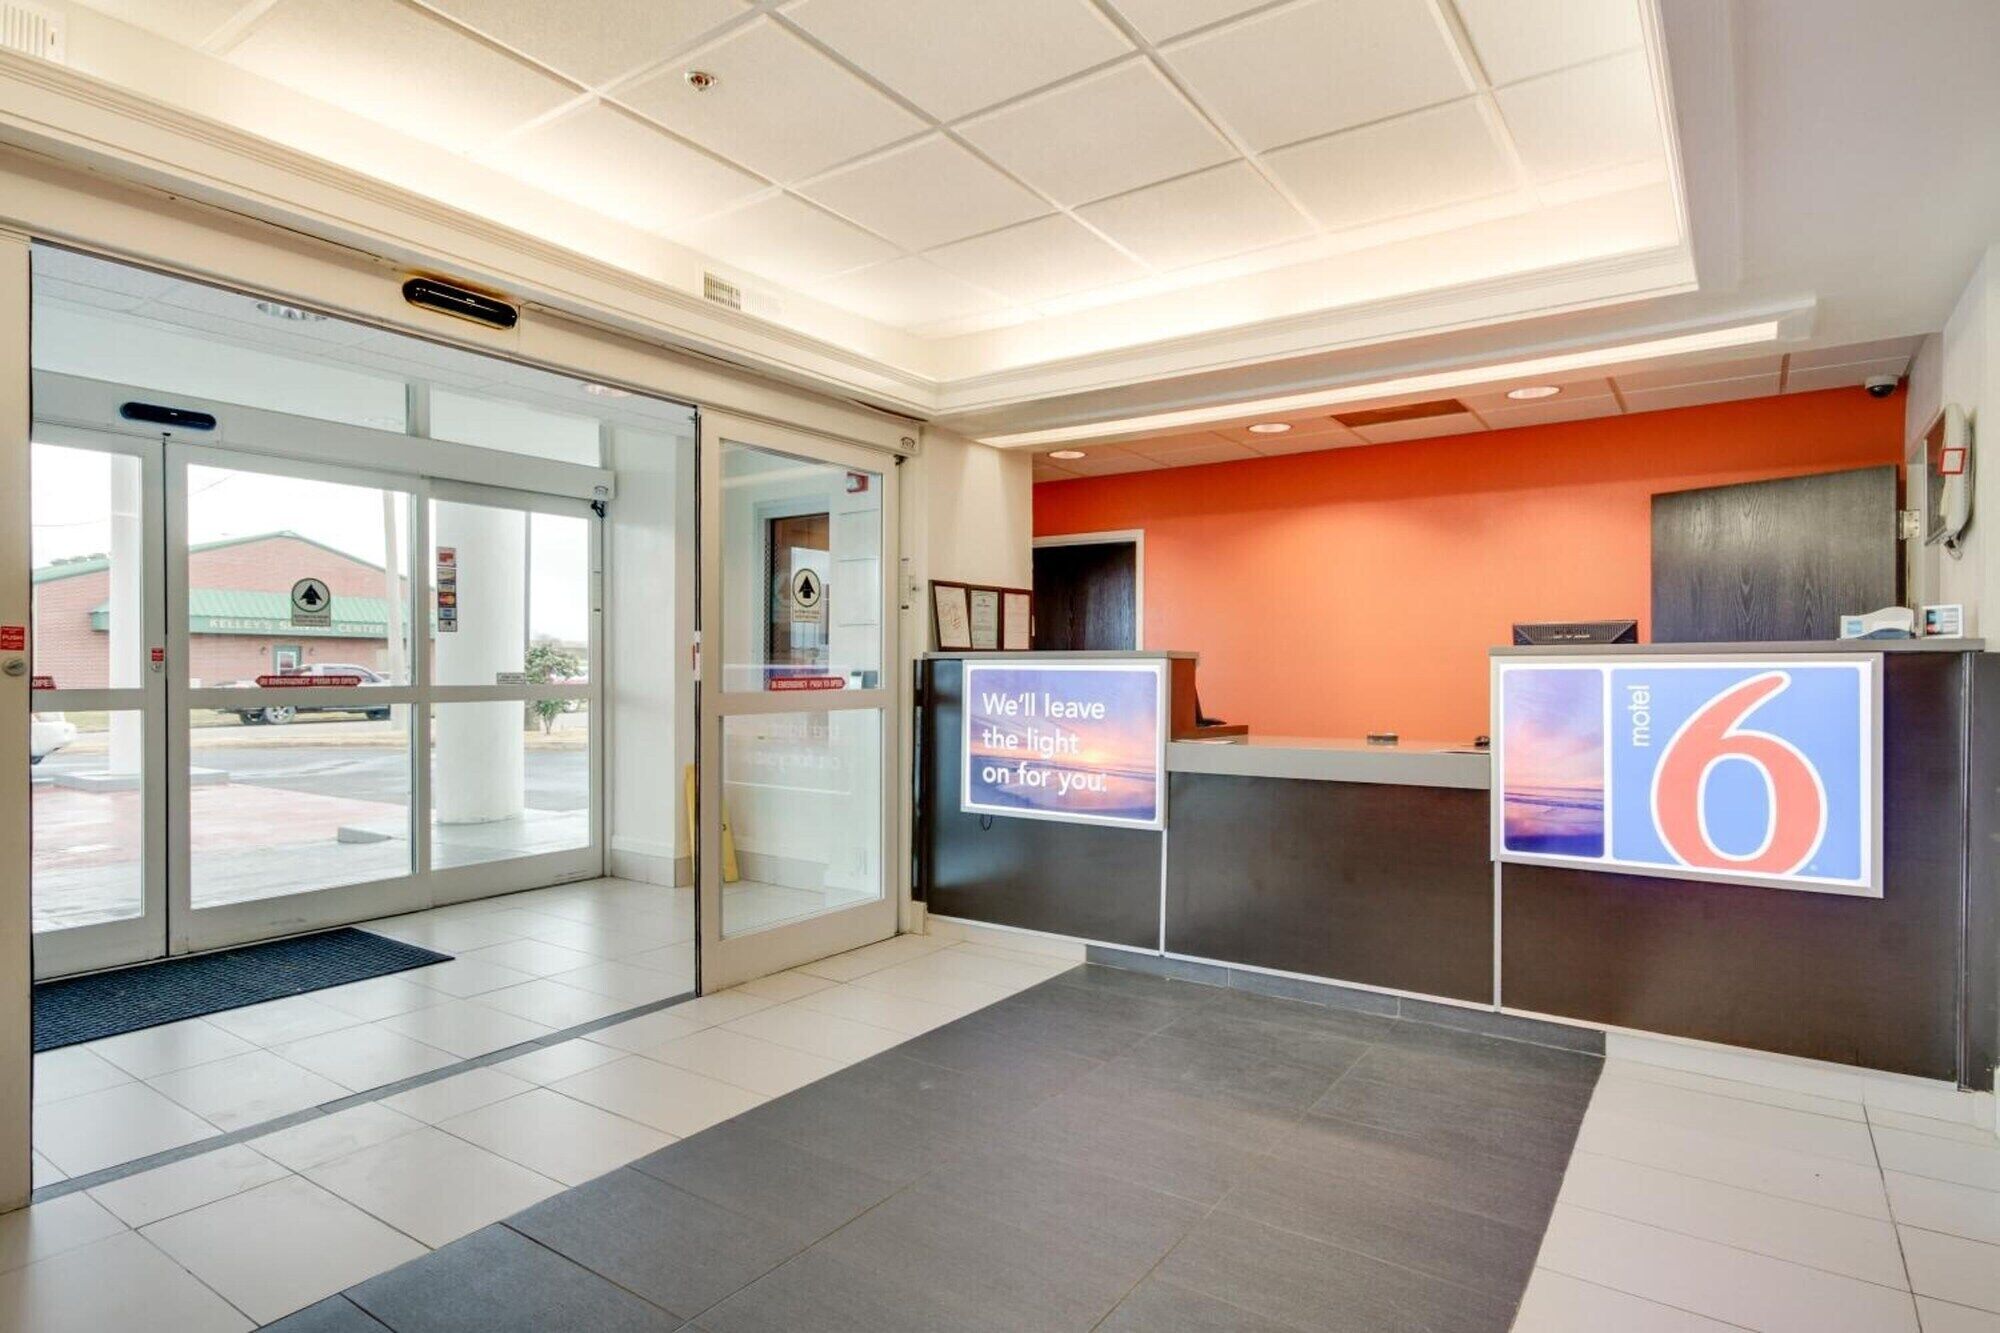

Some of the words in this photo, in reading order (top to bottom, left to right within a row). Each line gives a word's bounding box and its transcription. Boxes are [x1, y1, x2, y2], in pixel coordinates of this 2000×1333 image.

[338, 623, 384, 634] CENTER
[982, 692, 1036, 717] We'll
[1044, 692, 1106, 720] leave
[1626, 684, 1651, 747] motel
[982, 725, 1019, 749] the
[1027, 727, 1079, 760] light
[982, 765, 1010, 785] on
[1017, 760, 1051, 788] for
[1650, 670, 1828, 876] 6
